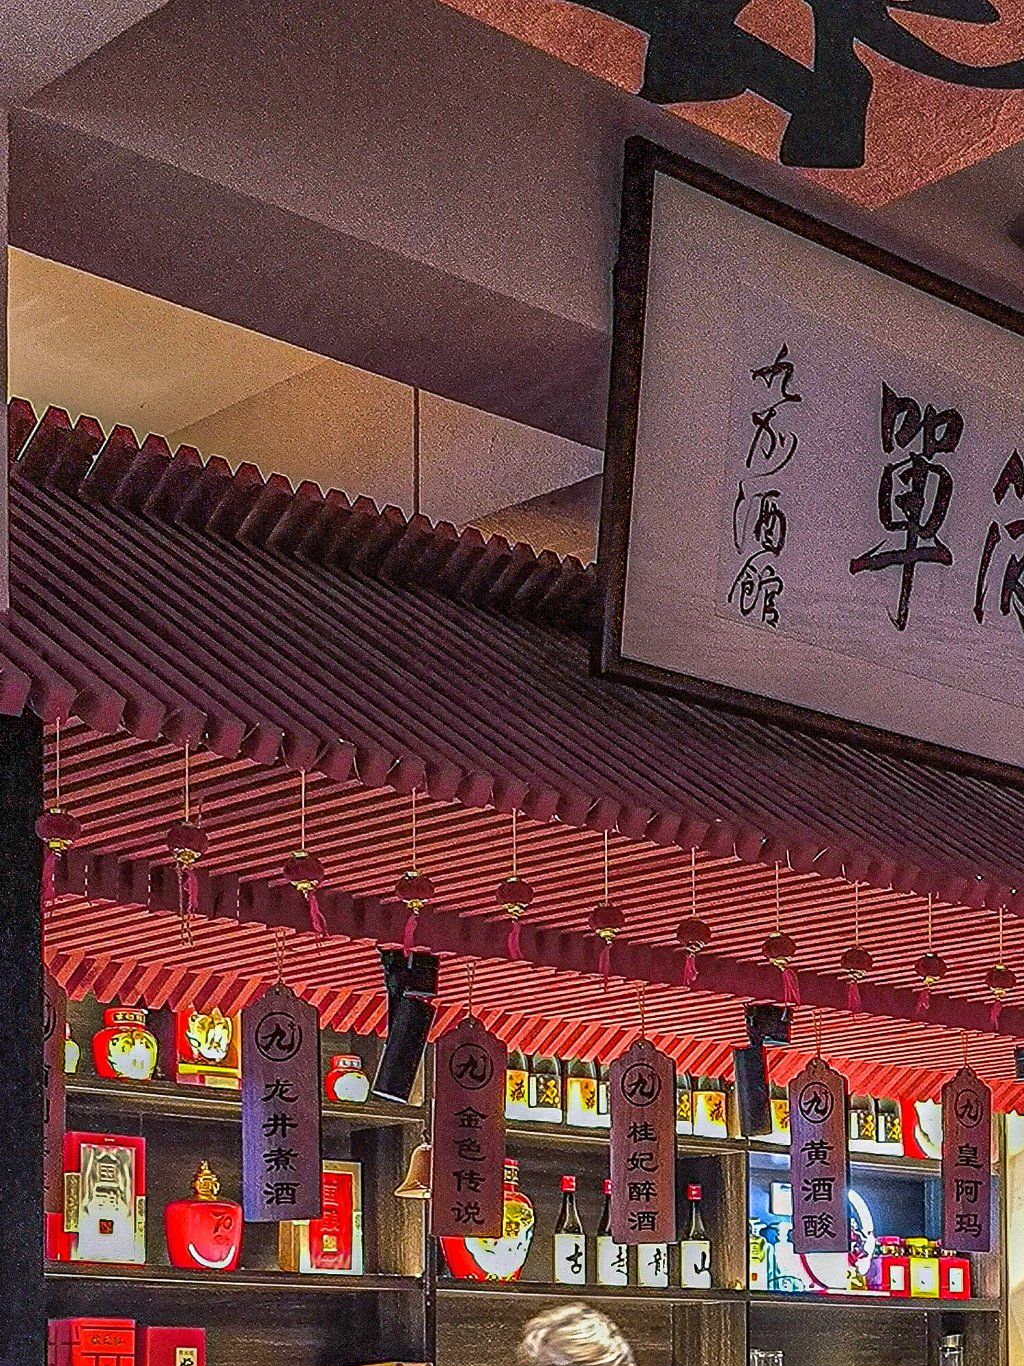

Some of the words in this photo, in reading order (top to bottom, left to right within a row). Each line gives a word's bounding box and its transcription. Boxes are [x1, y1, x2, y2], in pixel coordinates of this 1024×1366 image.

[260, 1078, 301, 1206] 龙井煮酒
[451, 1105, 488, 1226] 金色传说
[626, 1121, 659, 1232] 桂妃醉酒
[800, 1139, 837, 1240] 黄酒酸
[954, 1142, 984, 1239] 皇阿玛
